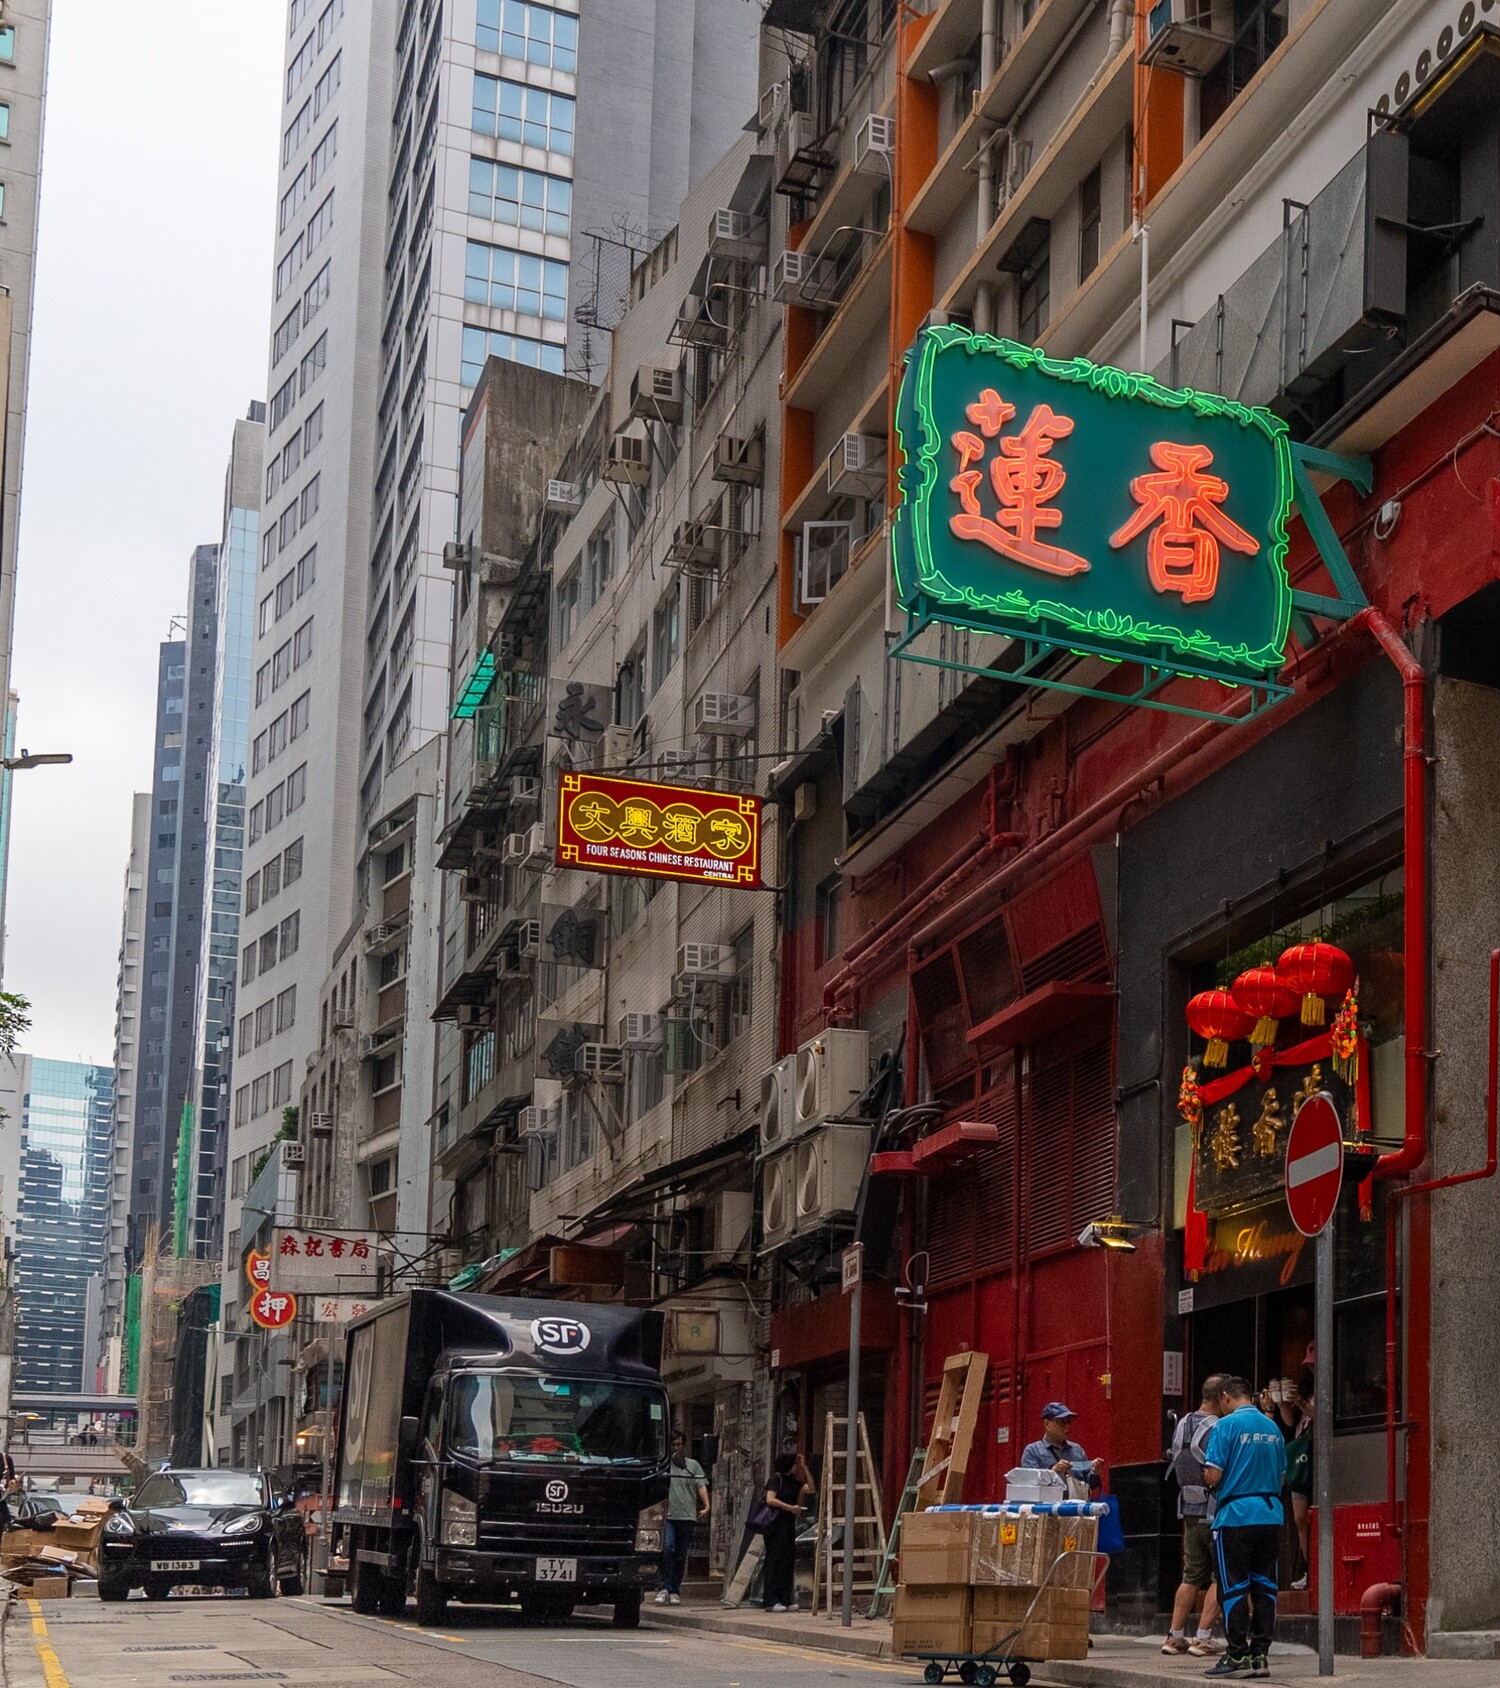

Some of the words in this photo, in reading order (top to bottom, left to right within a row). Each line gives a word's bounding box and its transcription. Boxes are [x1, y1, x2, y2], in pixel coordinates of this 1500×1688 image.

[949, 388, 1261, 604] 蓮香
[575, 802, 745, 851] 文興酒家
[586, 844, 609, 857] FOUR
[609, 846, 647, 861] SEASONS
[648, 851, 683, 866] CHINESE
[684, 855, 734, 872] RESTAURANT
[280, 1235, 370, 1260] 森記書局
[536, 1502, 584, 1514] ISUZU
[171, 1562, 195, 1570] 1383
[548, 1559, 566, 1570] TY
[540, 1569, 573, 1580] 3741
